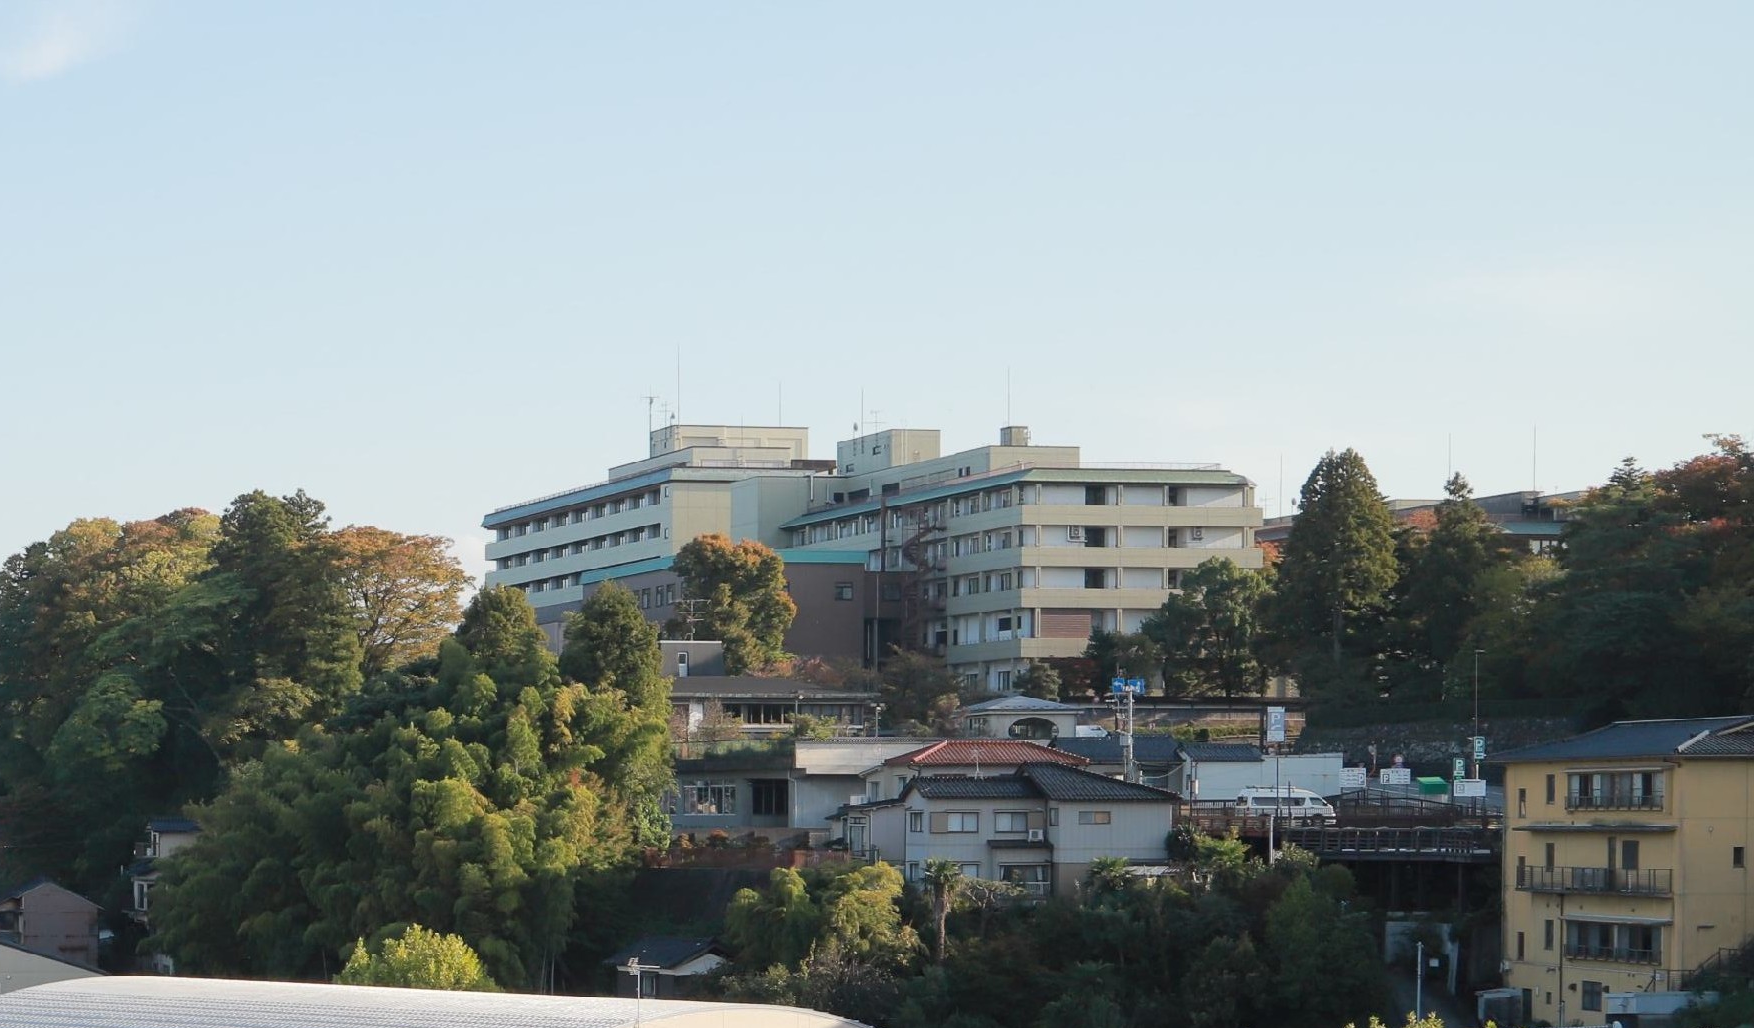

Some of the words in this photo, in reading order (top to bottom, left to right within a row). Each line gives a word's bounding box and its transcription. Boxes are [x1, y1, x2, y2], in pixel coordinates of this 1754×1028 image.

[1271, 712, 1281, 725] P
[1475, 739, 1483, 751] P
[1456, 759, 1464, 770] P
